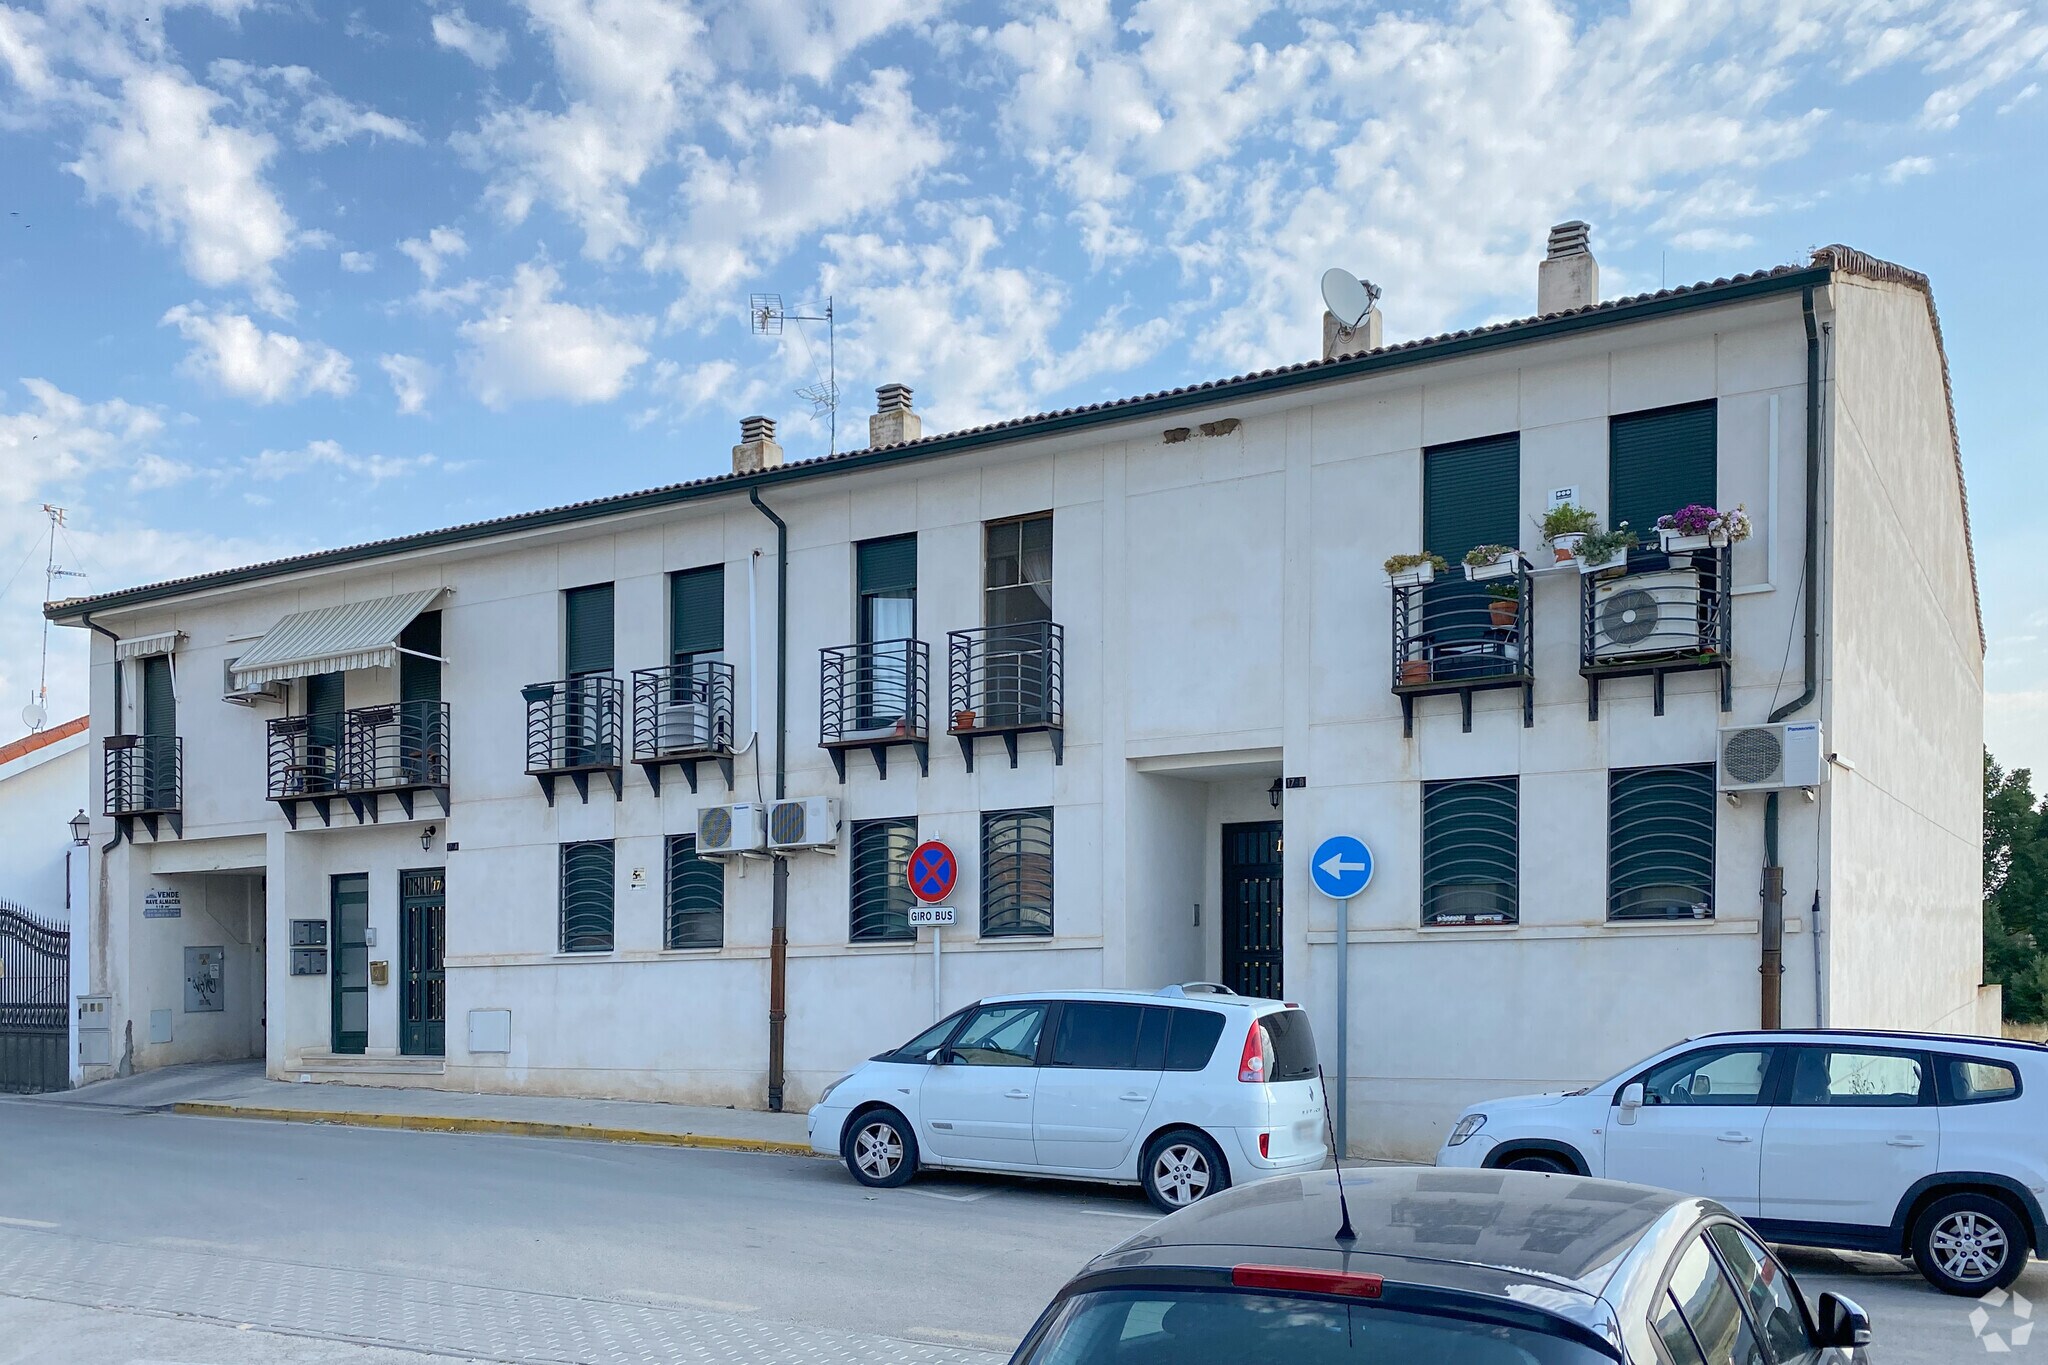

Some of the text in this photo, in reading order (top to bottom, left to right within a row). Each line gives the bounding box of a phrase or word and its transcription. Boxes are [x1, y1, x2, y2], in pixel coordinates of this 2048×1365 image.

[433, 880, 441, 890] 17
[911, 911, 952, 921] GIRO BUS
